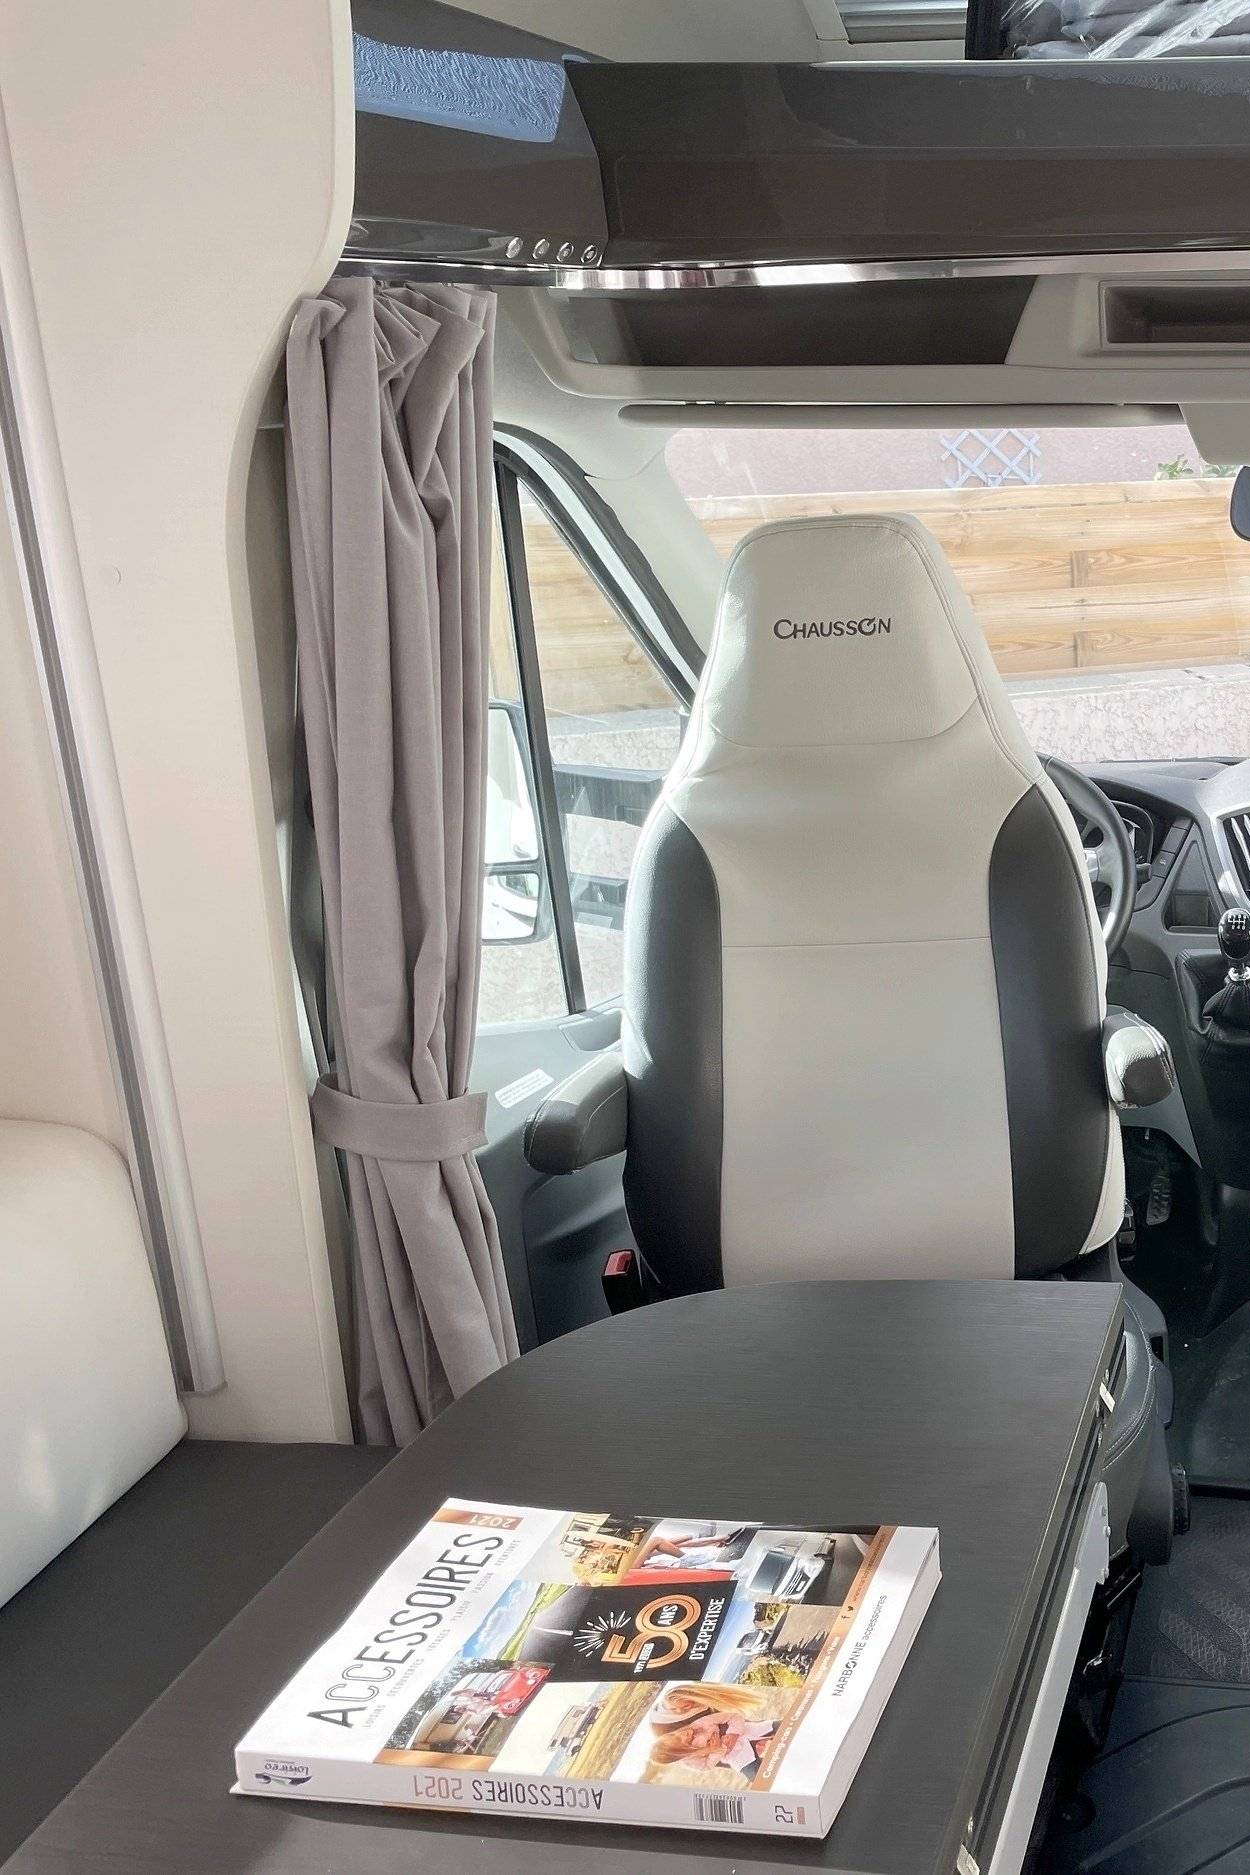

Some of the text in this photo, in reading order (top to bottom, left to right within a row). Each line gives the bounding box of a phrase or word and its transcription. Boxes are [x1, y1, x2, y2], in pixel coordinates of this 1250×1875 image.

[773, 617, 891, 640] CHAUSSON
[469, 1513, 517, 1529] 2021
[306, 1533, 504, 1729] ACCESSOIRES
[600, 1594, 702, 1669] 50
[657, 1604, 679, 1626] ANS
[688, 1597, 726, 1661] D'EXPERTISE
[832, 1641, 867, 1697] NARBONNE
[861, 1594, 888, 1641] accessoires
[412, 1774, 604, 1810] ACCESSOIRES 2021
